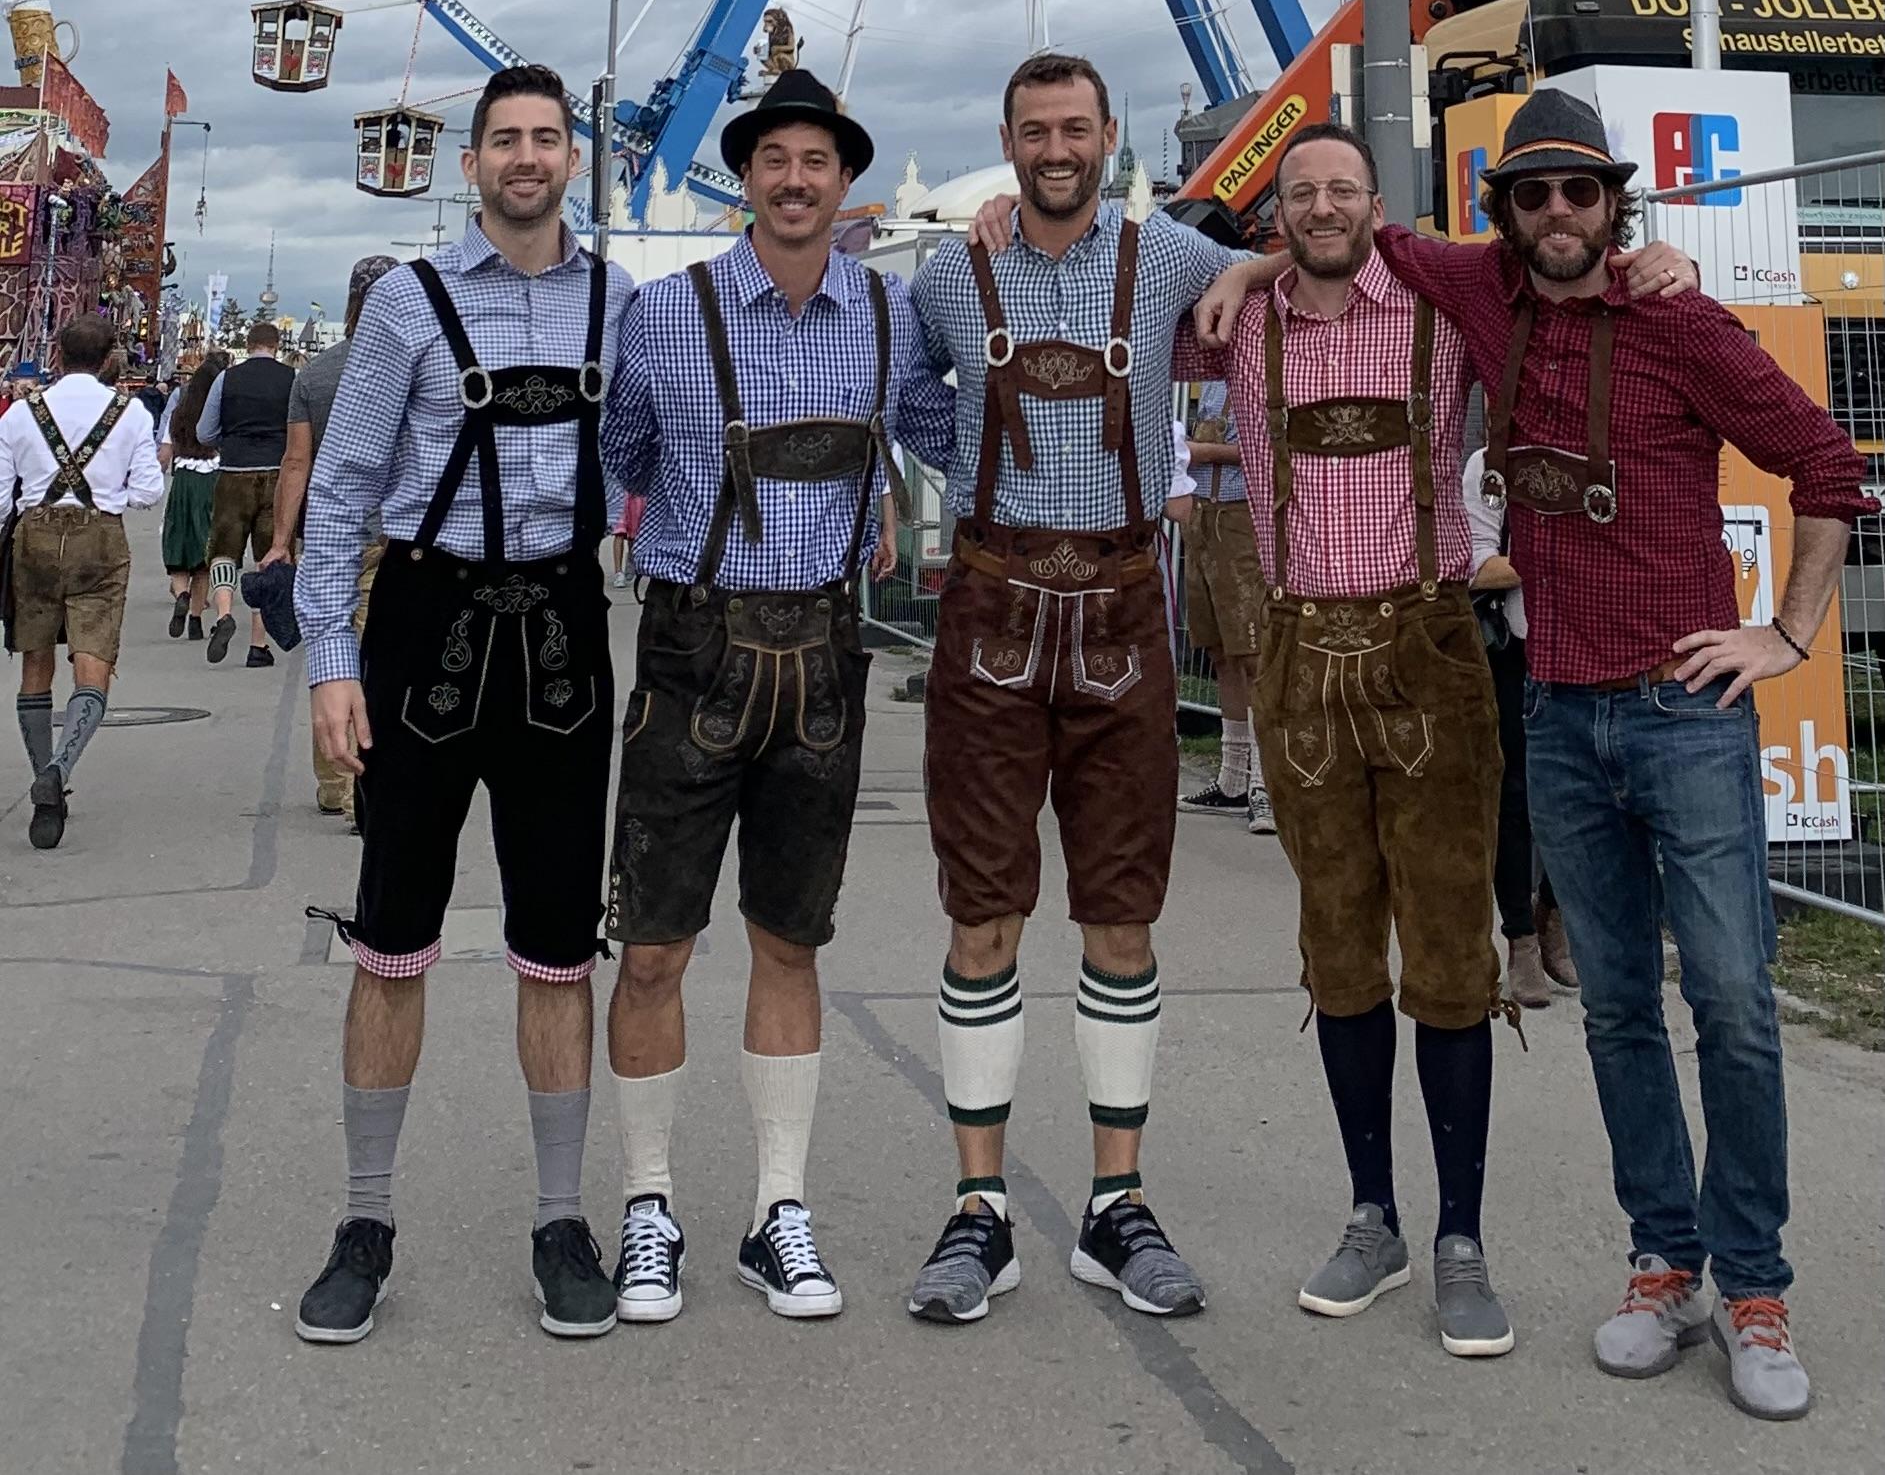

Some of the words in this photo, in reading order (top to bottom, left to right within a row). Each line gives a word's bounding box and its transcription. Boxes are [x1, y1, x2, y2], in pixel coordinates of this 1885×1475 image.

[1683, 27, 1885, 54] Shaustellerbet
[1219, 102, 1301, 194] PALFINGER
[1752, 269, 1796, 282] ICCash
[1802, 816, 1838, 828] ICCash
